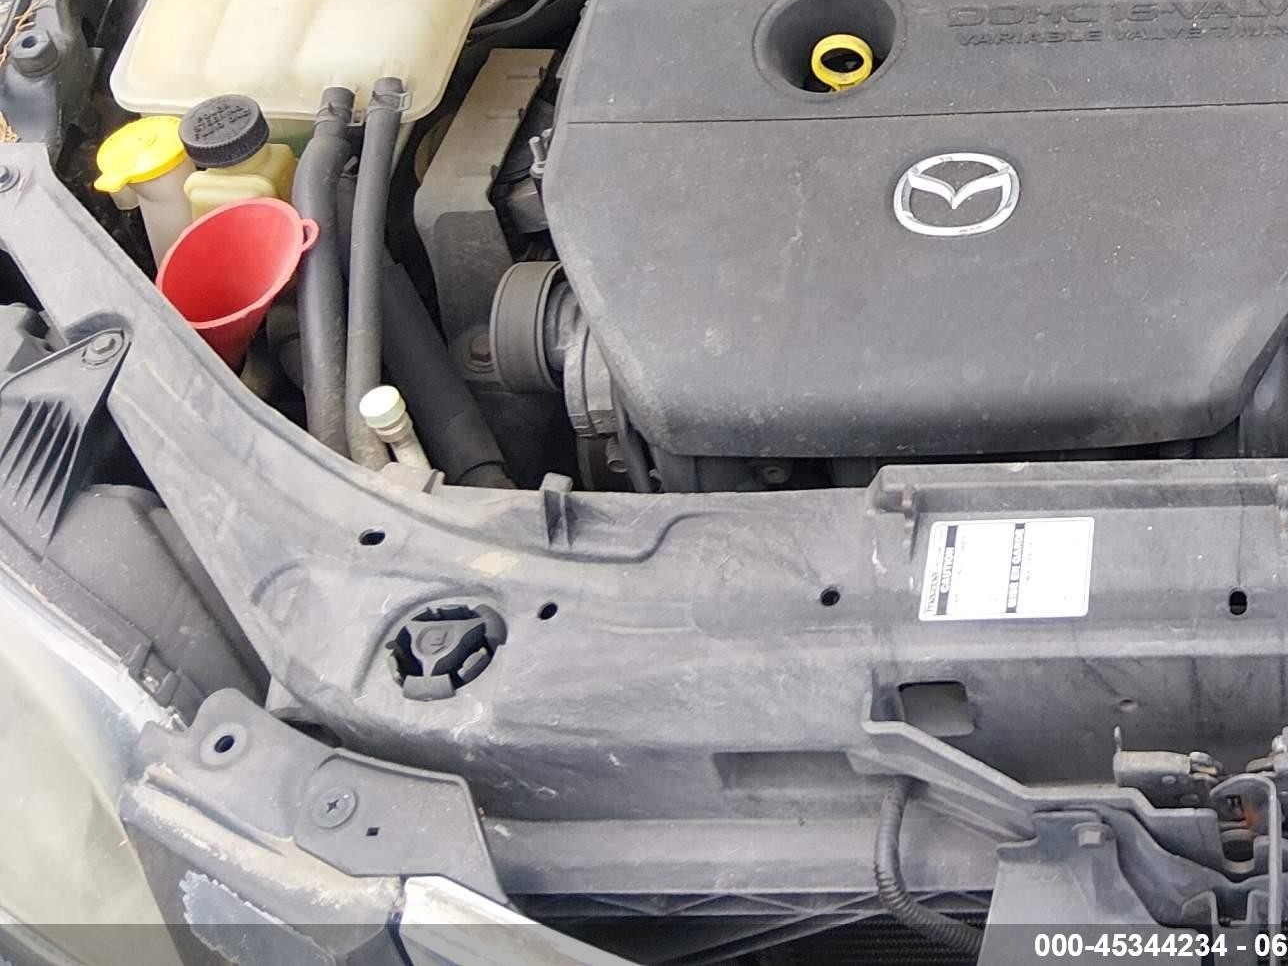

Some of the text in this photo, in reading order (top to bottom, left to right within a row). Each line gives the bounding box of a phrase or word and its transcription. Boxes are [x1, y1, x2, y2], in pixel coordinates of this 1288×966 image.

[946, 3, 1101, 28] DOHC
[958, 29, 1103, 47] VARIABLE
[939, 546, 955, 594] CAUTION
